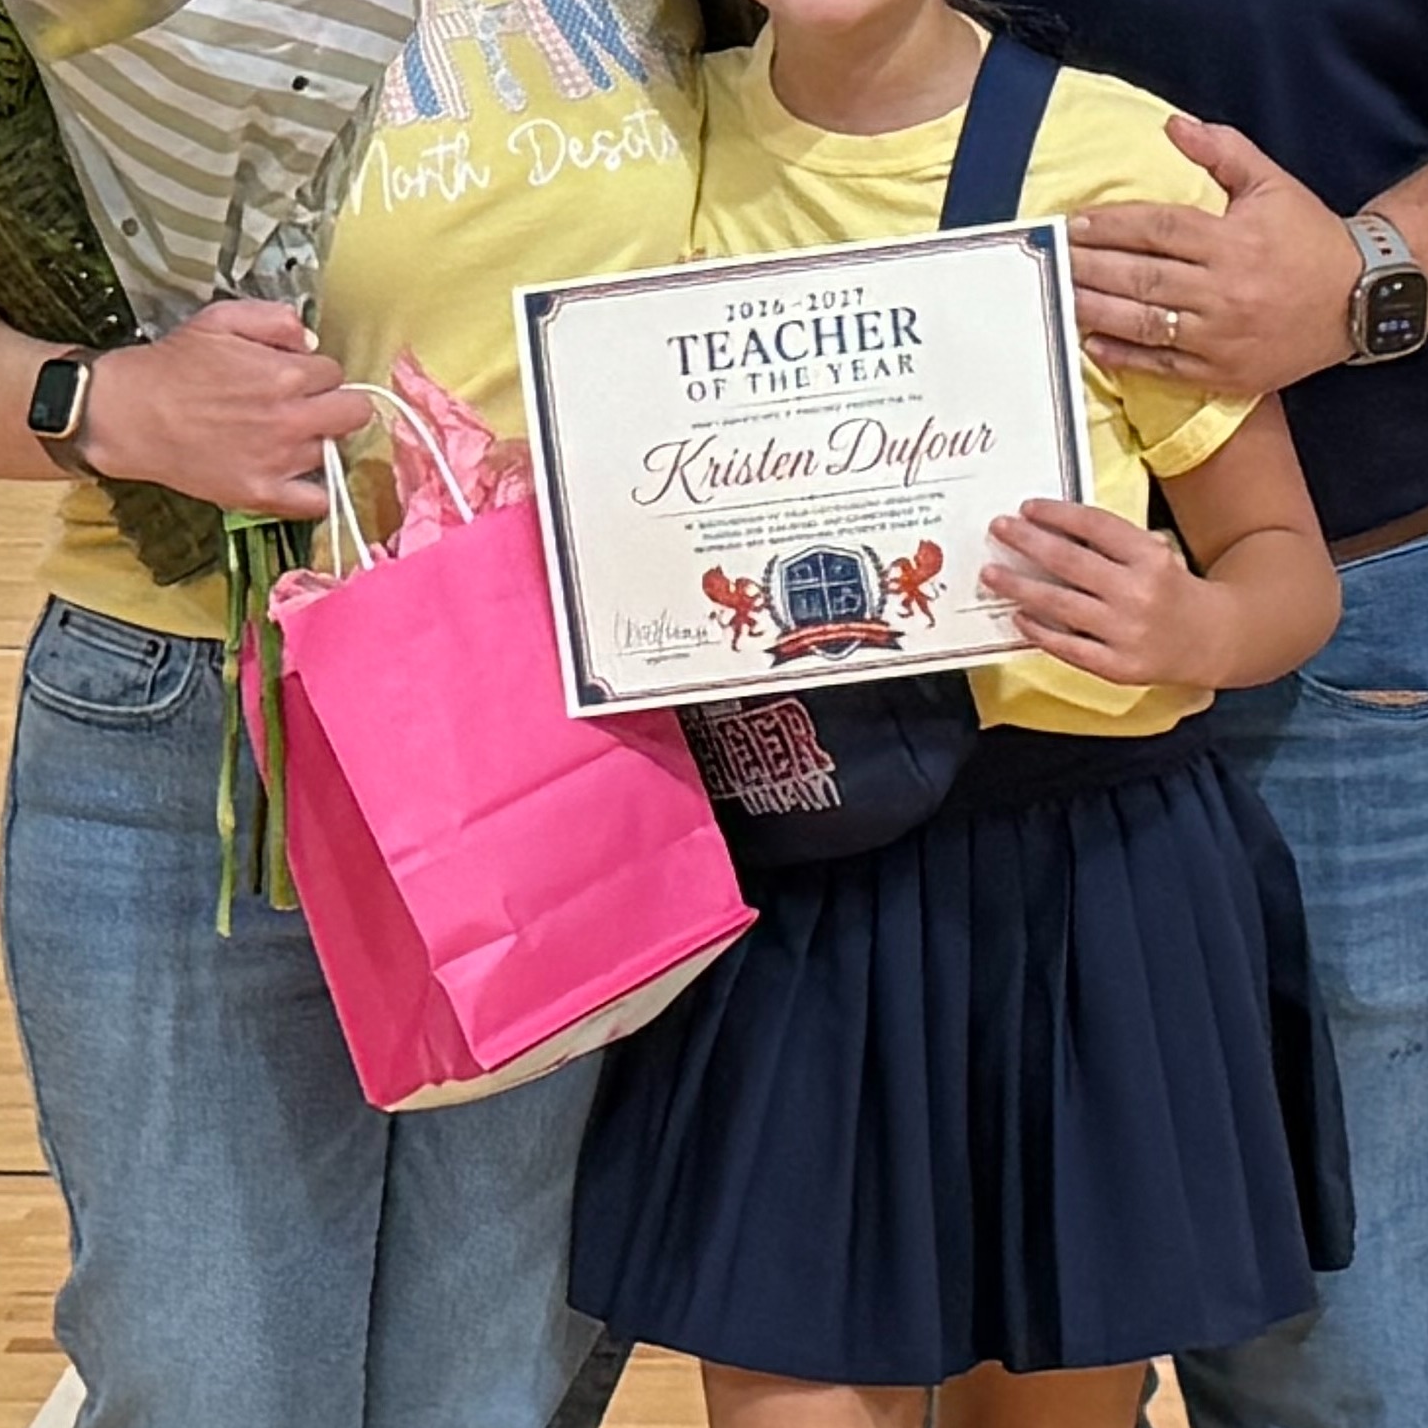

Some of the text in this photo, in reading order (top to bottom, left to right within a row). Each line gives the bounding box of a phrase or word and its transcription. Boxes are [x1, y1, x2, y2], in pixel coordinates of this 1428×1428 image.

[350, 130, 490, 216] North
[667, 306, 923, 376] TEACHER
[686, 353, 915, 402] OF THE YEAR
[631, 416, 995, 505] Kristen Dufour
